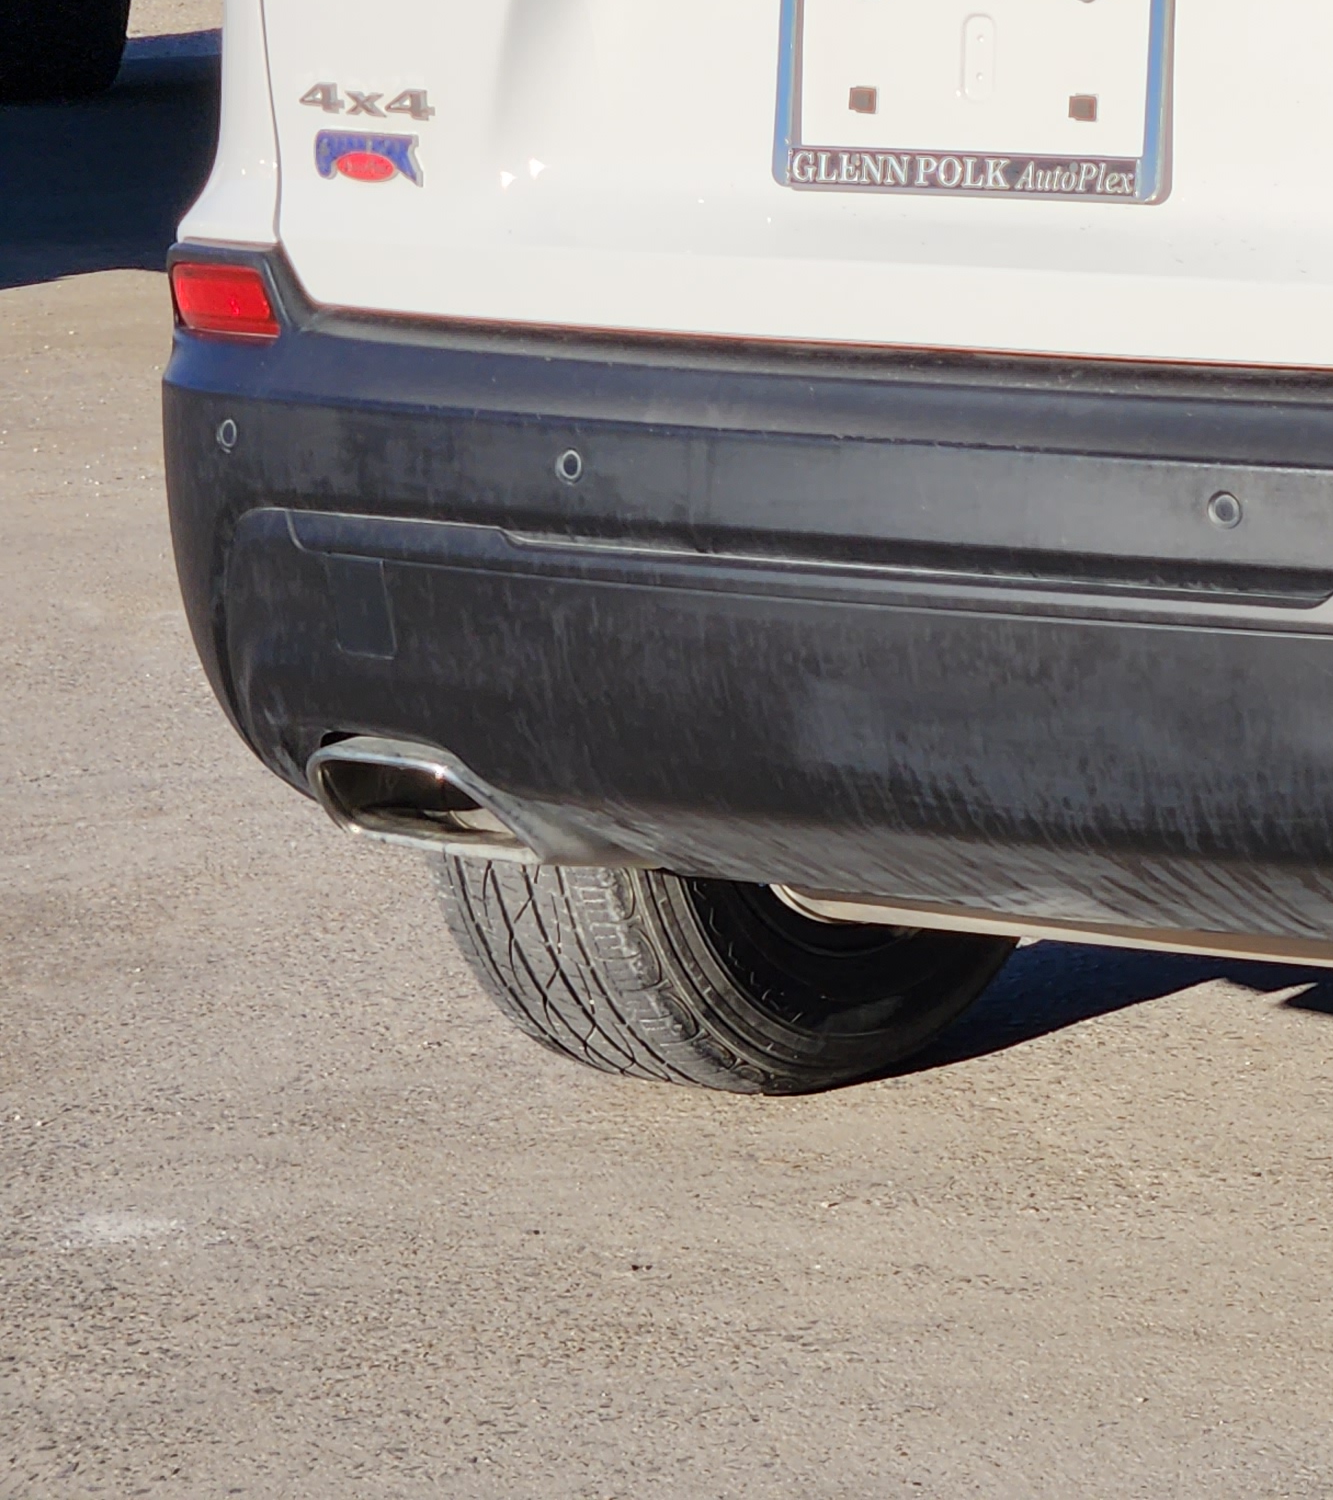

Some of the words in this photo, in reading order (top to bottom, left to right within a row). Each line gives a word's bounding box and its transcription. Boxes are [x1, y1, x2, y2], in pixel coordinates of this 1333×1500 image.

[299, 82, 435, 121] 4x4
[791, 149, 909, 187] GLENN
[915, 155, 1011, 190] POLK
[1015, 160, 1135, 196] AutoPlex
